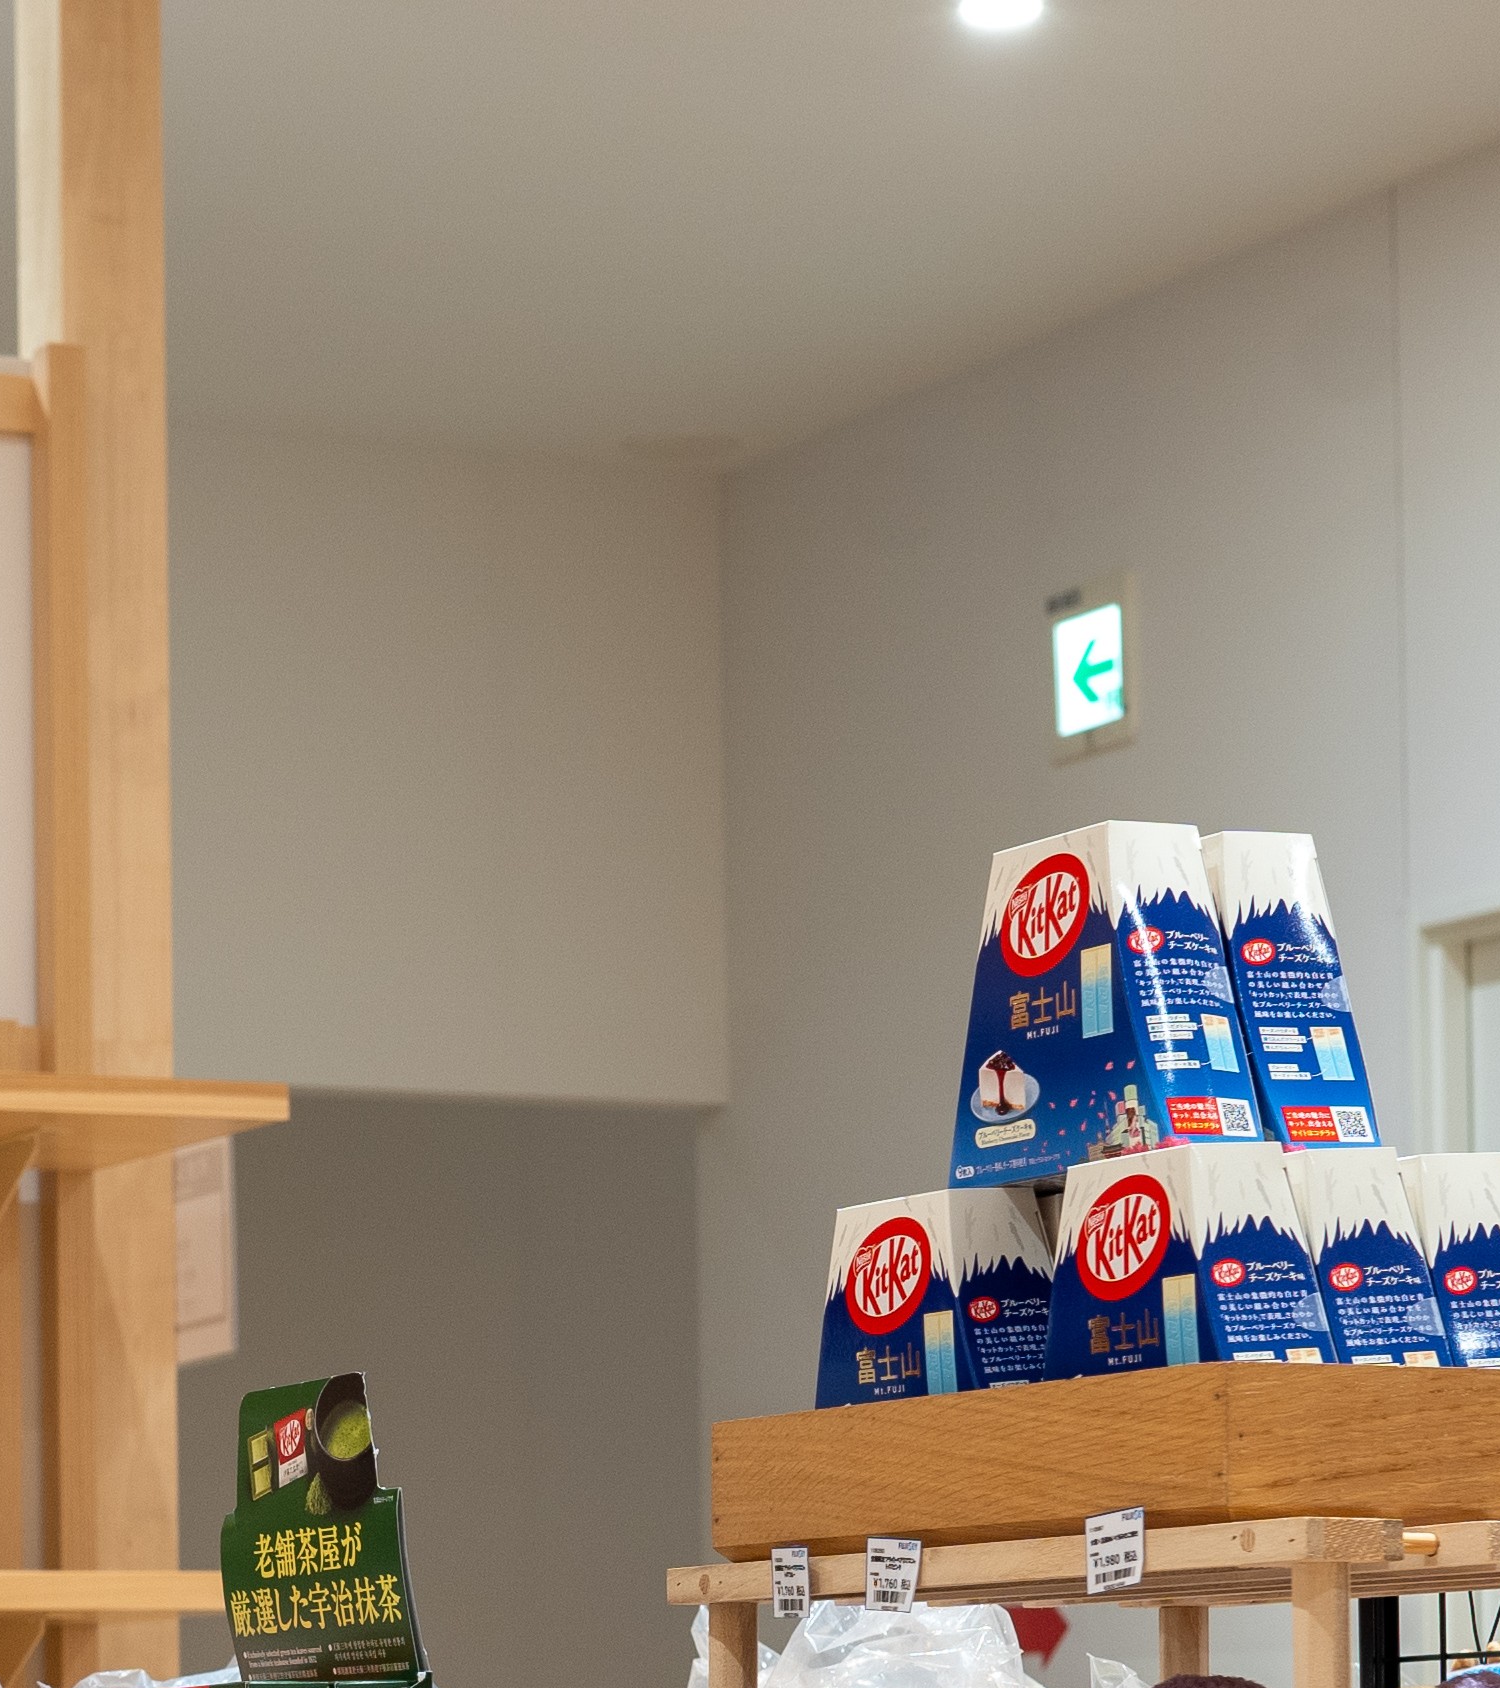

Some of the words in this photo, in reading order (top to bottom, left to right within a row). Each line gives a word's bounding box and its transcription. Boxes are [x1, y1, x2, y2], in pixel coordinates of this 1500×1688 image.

[1018, 873, 1078, 956] KitKat
[1009, 980, 1077, 1030] 富士山
[1095, 1196, 1157, 1279] KitKat
[863, 1237, 919, 1315] KitKat
[1246, 1261, 1295, 1272] ブルーベリー
[1364, 1265, 1411, 1275] ブルーベリー
[1001, 1298, 1047, 1308] ブルーベリー
[1088, 1308, 1160, 1355] 富士山
[856, 1343, 921, 1385] 富士山
[254, 1522, 362, 1579] 老舗茶屋が
[230, 1574, 402, 1638] 厳選した宇治抹茶
